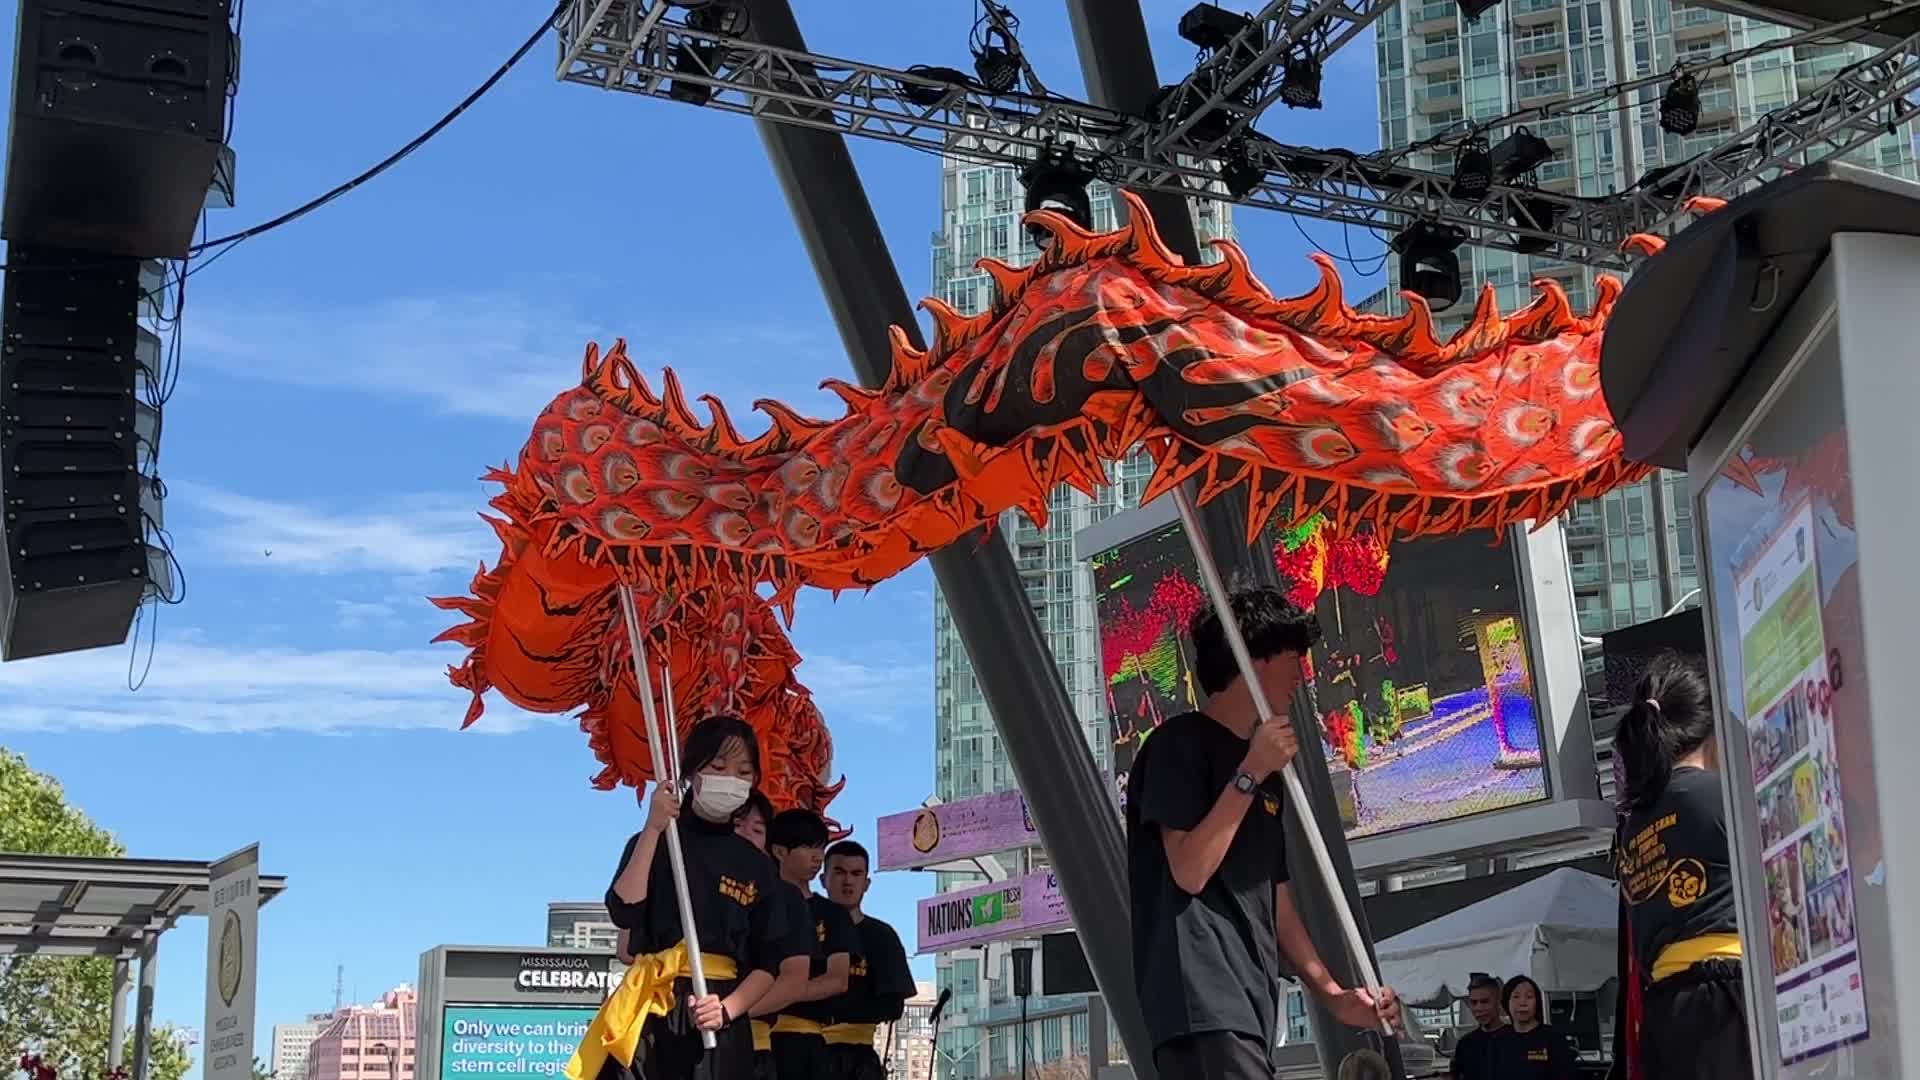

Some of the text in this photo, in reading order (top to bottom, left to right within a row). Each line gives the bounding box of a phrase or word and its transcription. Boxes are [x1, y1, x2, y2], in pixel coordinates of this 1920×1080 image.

[928, 898, 972, 936] NATIONS
[521, 957, 589, 968] MISSISSAUGA
[453, 1019, 493, 1038] Only
[496, 1023, 520, 1036] we
[523, 1023, 553, 1036] can
[452, 1038, 574, 1056] diversity to the
[452, 1058, 493, 1072] stem
[497, 1057, 526, 1072] cell
